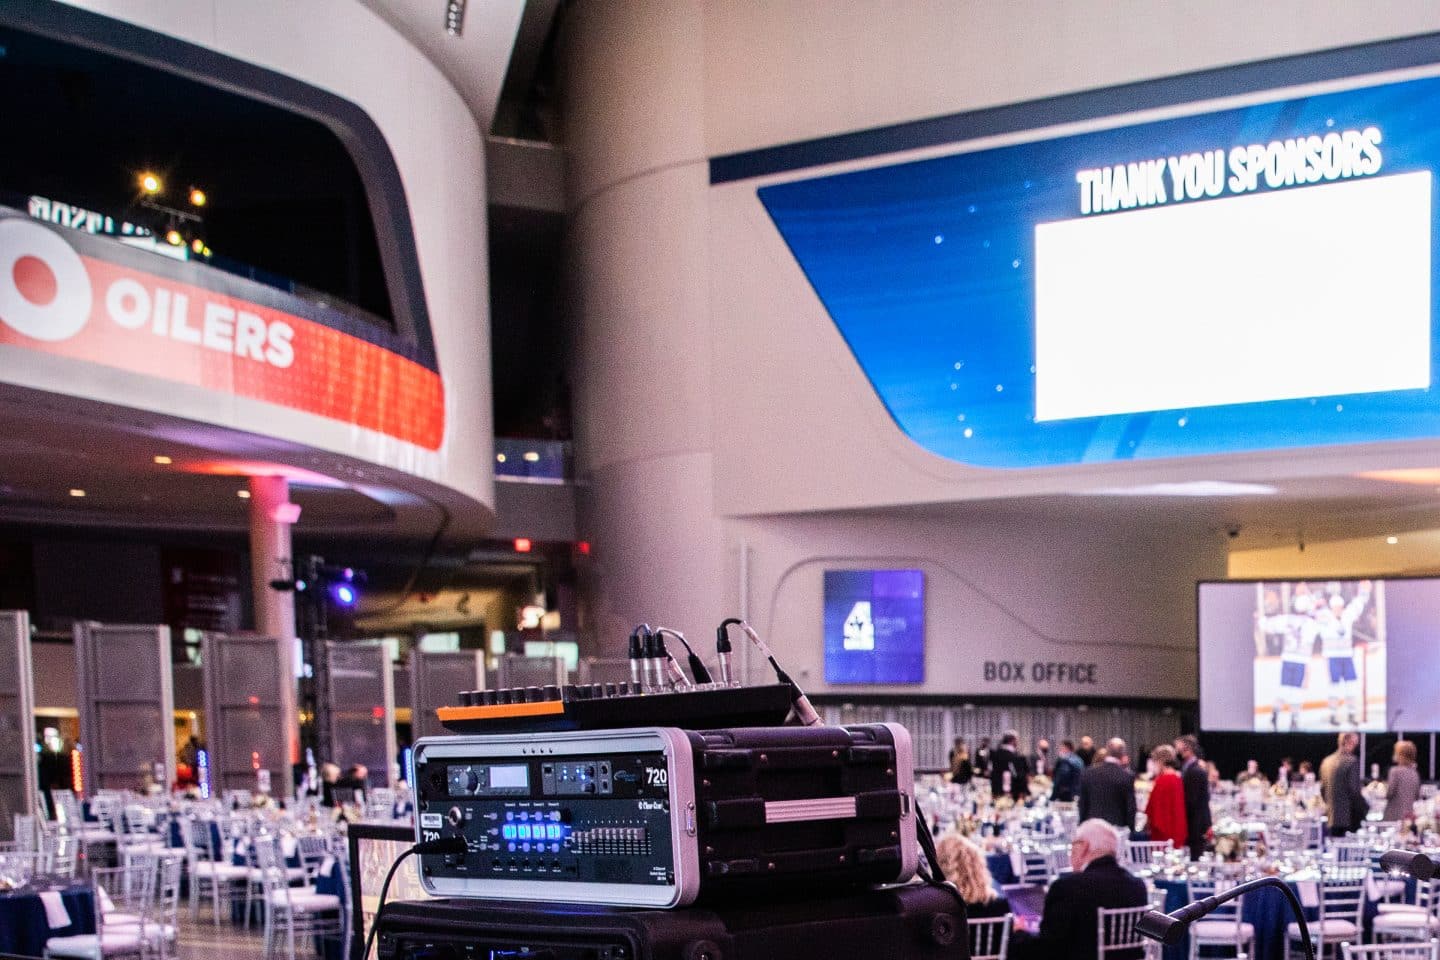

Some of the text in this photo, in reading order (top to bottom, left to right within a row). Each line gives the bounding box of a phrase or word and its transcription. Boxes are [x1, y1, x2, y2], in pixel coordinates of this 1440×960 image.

[1076, 127, 1382, 214] THANK YOU SPONSORS
[106, 278, 295, 368] OILERS
[984, 661, 1097, 684] BOX OFFICE
[646, 768, 667, 784] 720
